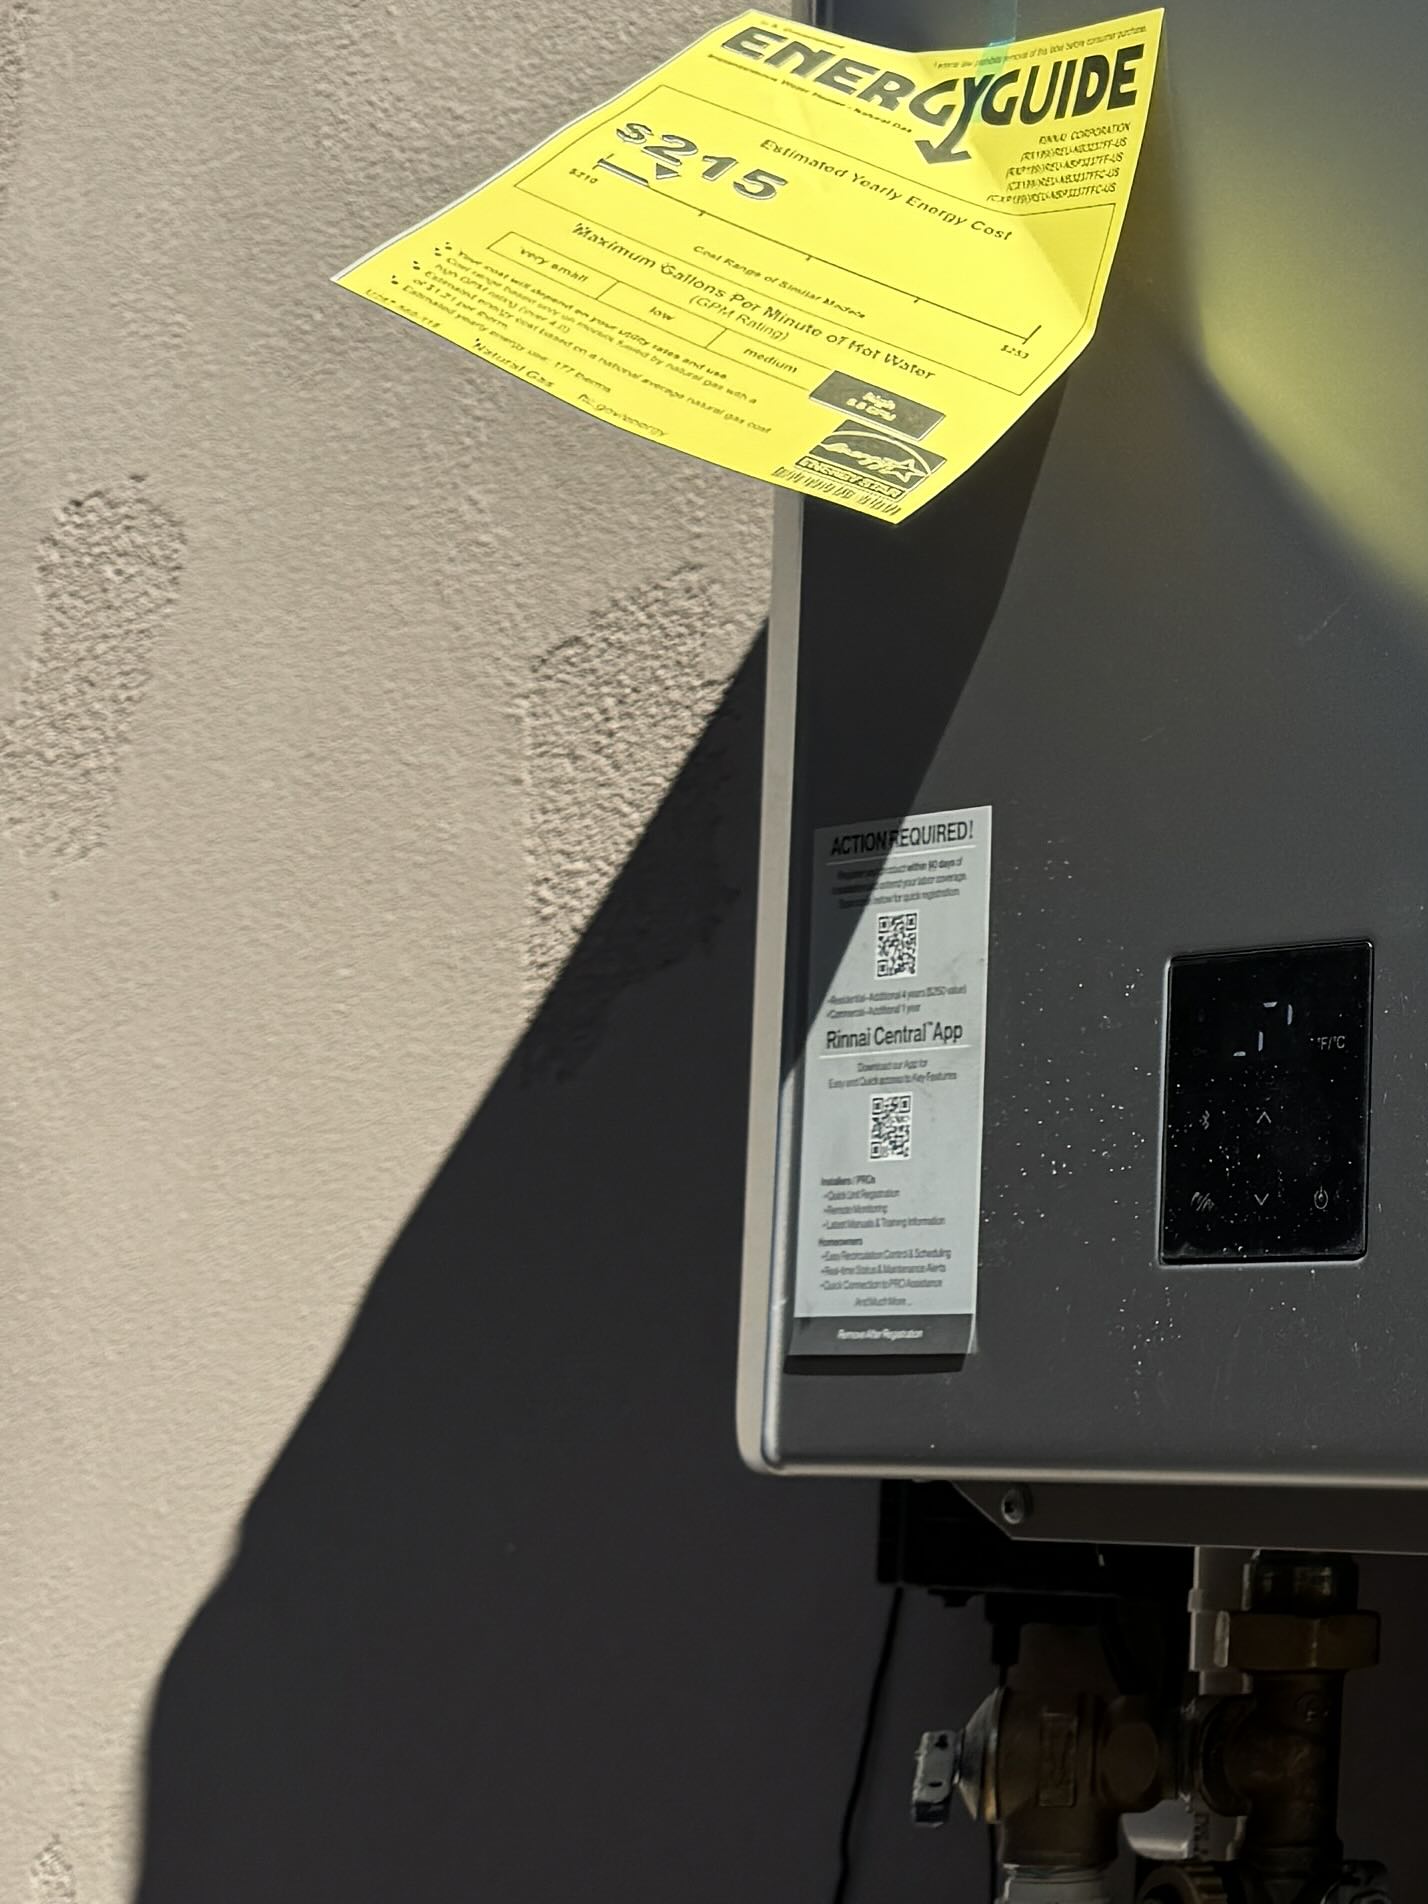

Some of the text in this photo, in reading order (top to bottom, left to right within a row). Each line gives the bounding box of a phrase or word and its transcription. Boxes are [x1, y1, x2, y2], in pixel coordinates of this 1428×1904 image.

[720, 26, 1145, 164] ENERGYGUIDE
[1071, 121, 1130, 141] CORPORATION
[616, 122, 789, 201] $215
[760, 138, 1013, 241] Estimated Yearly Energy Cost
[519, 246, 590, 283] very small
[571, 222, 937, 380] Maximum Gallons Per Minute of Hot Water
[649, 306, 676, 321] low
[736, 313, 790, 342] Rating)
[474, 343, 556, 388] Natural Gas
[743, 347, 800, 375] medium
[832, 820, 974, 856] ACTION REQUIRED!
[826, 1027, 871, 1049] Rinnai
[933, 1021, 963, 1045] App
